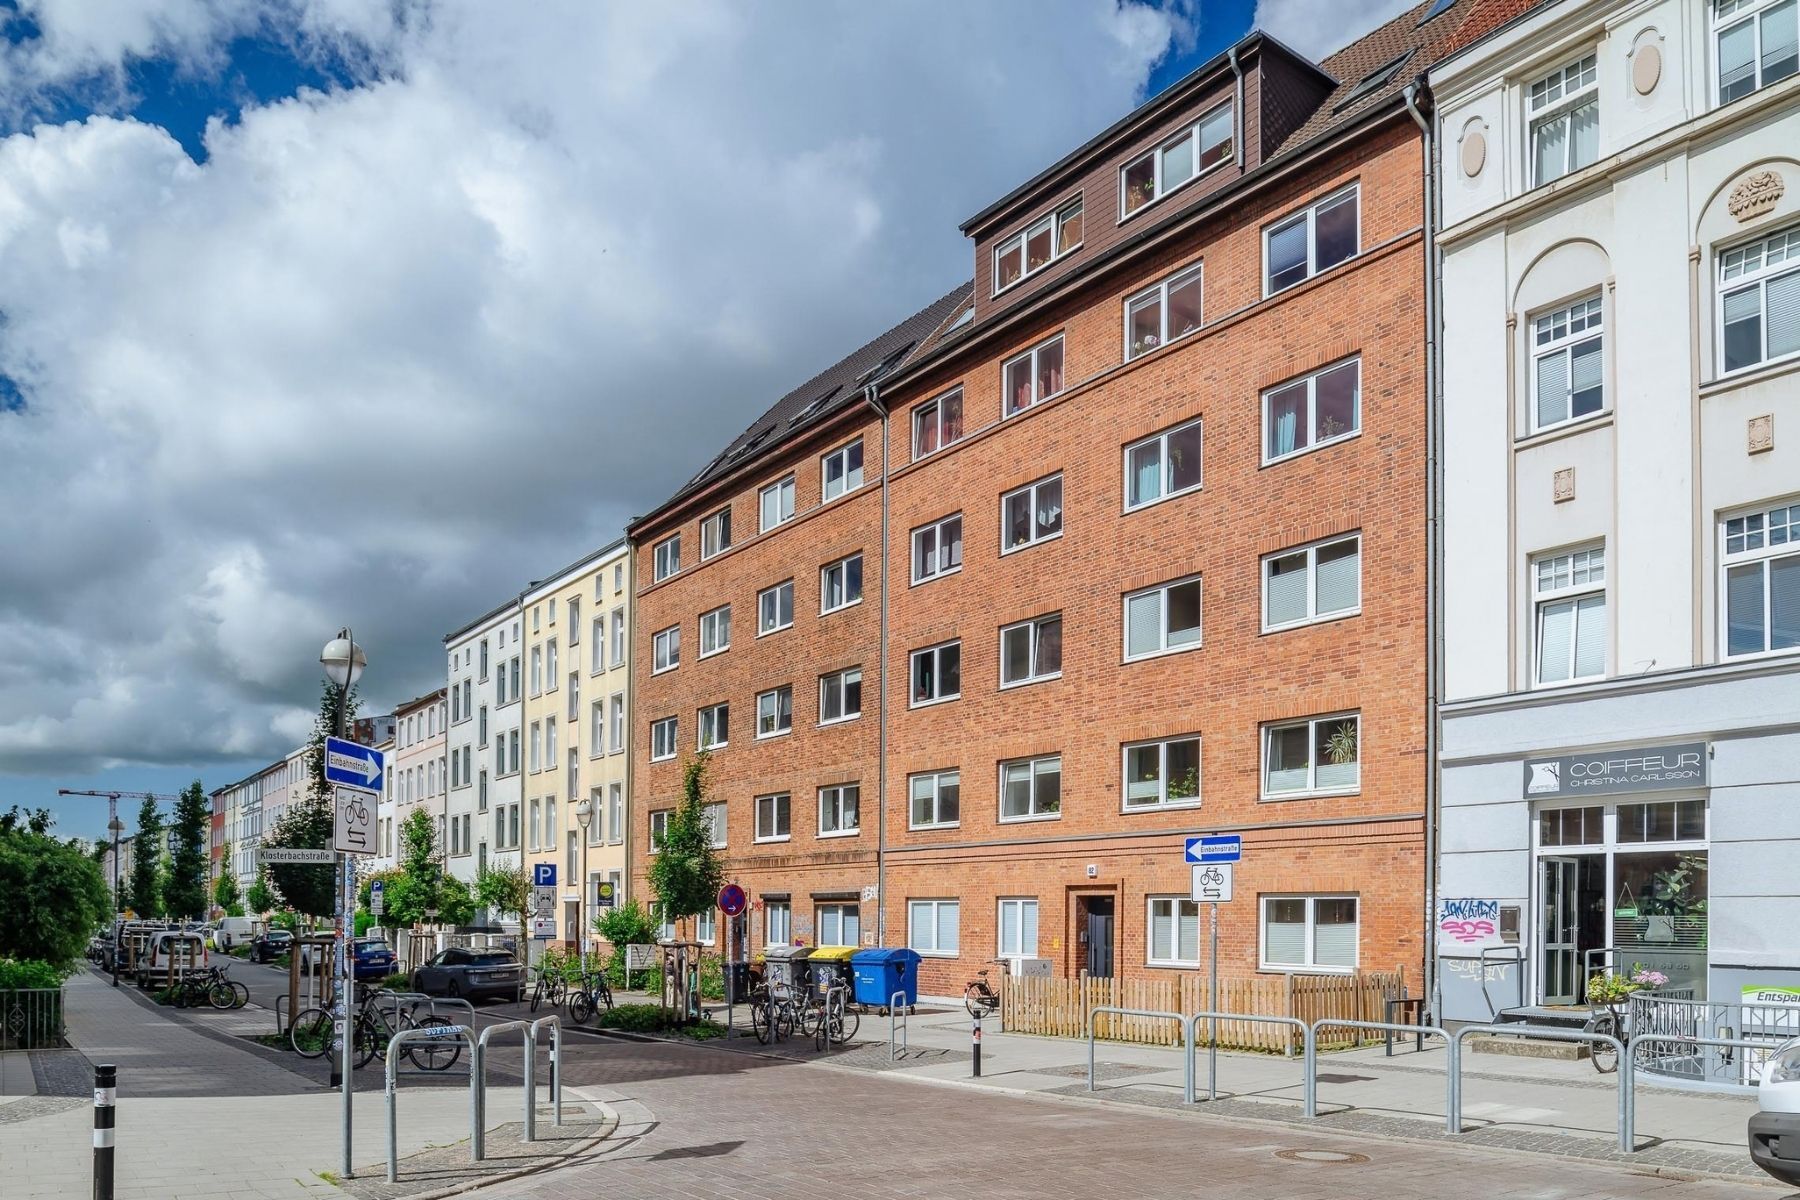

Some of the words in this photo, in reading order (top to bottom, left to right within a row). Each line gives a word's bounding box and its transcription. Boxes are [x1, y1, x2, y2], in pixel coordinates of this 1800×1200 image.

[330, 754, 369, 773] Einbahnstraße
[1570, 752, 1700, 777] COIFFEUR
[1570, 777, 1629, 788] CHRISTINA
[1631, 770, 1700, 784] CARLSSON
[260, 851, 330, 860] Klosterbachstraße
[539, 866, 552, 884] P
[373, 881, 381, 890] P
